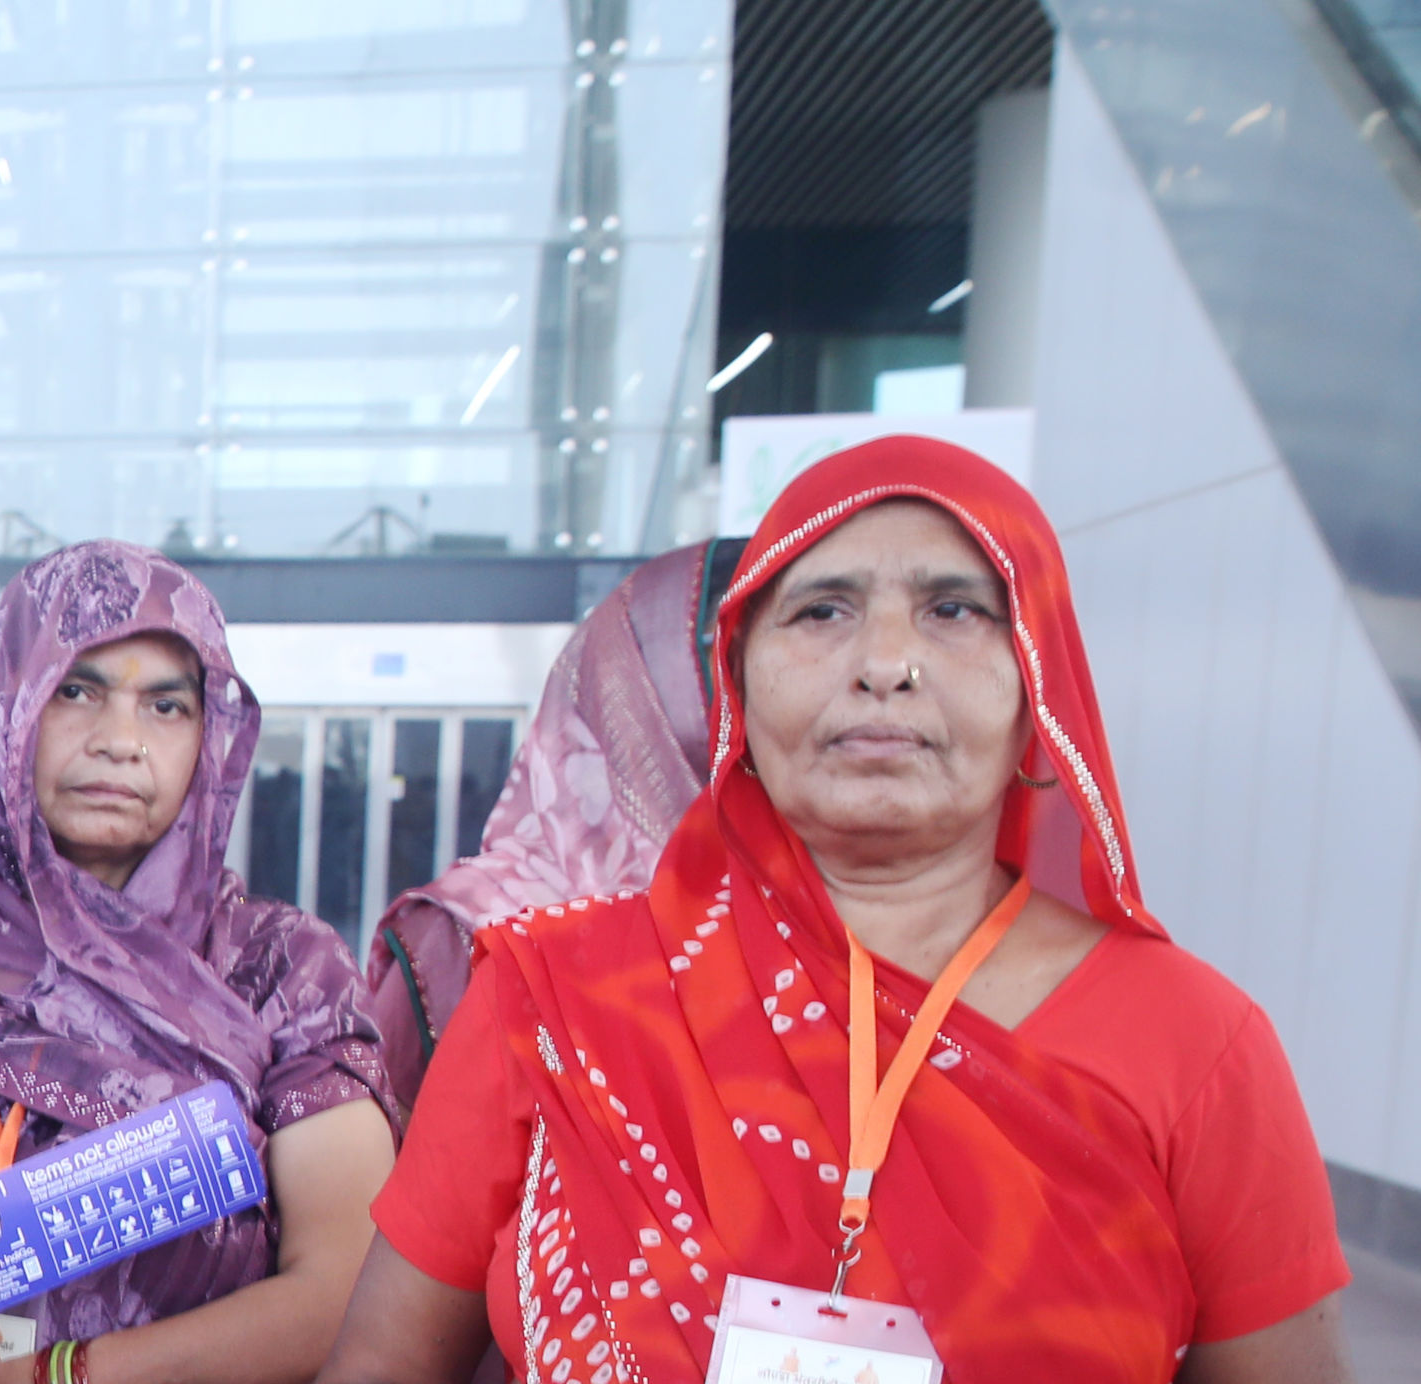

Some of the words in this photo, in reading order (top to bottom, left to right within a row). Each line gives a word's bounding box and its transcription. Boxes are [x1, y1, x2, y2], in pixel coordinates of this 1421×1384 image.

[21, 1157, 74, 1190] Items
[74, 1143, 107, 1170] not
[106, 1109, 178, 1152] allowed
